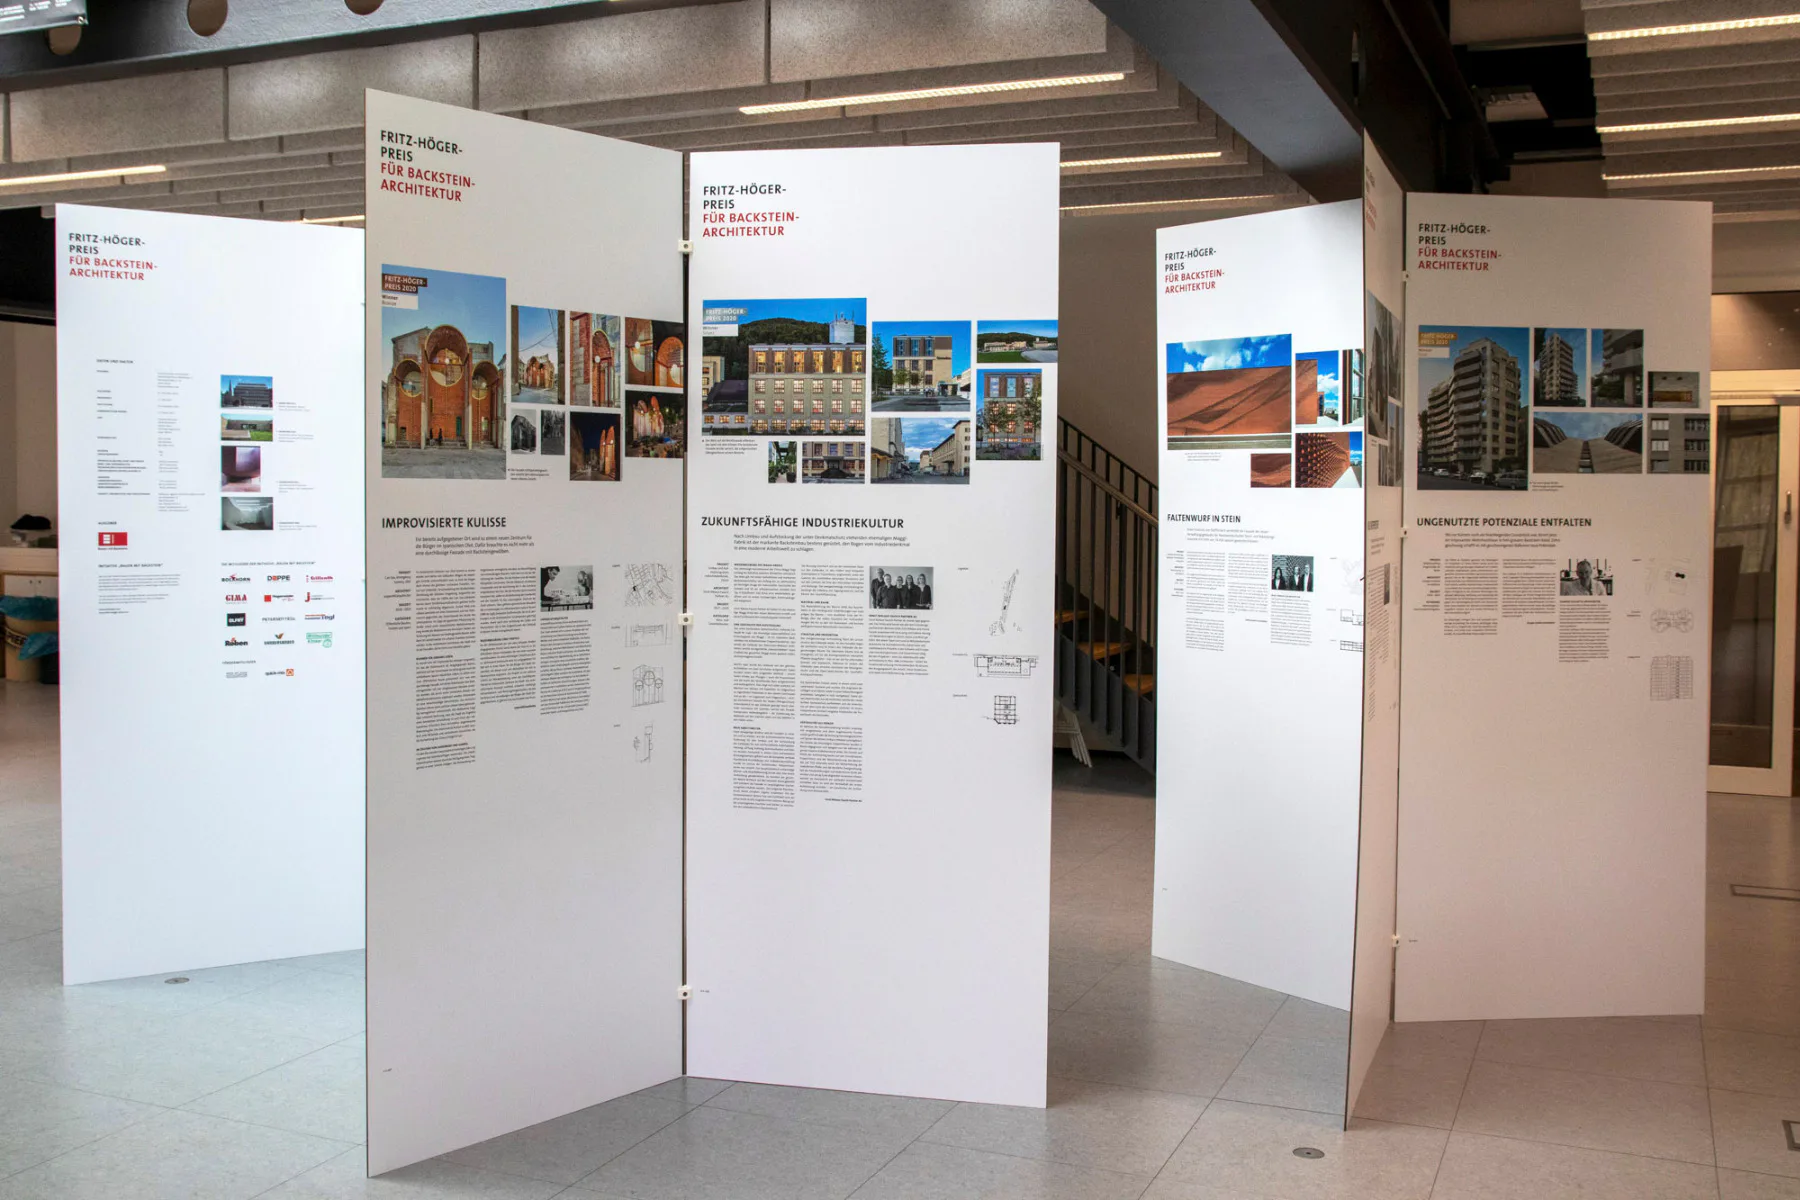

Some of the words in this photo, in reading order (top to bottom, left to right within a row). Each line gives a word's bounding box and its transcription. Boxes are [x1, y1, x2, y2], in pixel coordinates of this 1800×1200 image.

[381, 130, 463, 155] FRITZ-HÖGER-
[381, 146, 413, 162] PREIS
[381, 161, 403, 177] FÜR
[408, 167, 475, 188] BACKSTEIN-
[380, 179, 461, 202] ARCHITEKTUR
[703, 183, 786, 196] FRITZ-HÖGER-
[703, 199, 735, 210] PREIS
[703, 211, 725, 223] FÜR
[729, 211, 800, 223] BACKSTEIN-
[702, 225, 785, 238] ARCHITEKTUR
[1418, 222, 1491, 234] FRITZ-HÖGER-
[69, 232, 145, 246] FRITZ-HÖGER-
[1418, 235, 1446, 245] PREIS
[69, 244, 99, 255] PREIS
[1165, 247, 1217, 261] FRITZ-HÖGER-
[1418, 246, 1438, 257] FÜR
[1441, 248, 1502, 259] BACKSTEIN-
[69, 255, 90, 265] FÜR
[94, 257, 158, 270] BACKSTEIN-
[1165, 262, 1185, 272] PREIS
[1418, 260, 1489, 271] ARCHITEKTUR
[69, 268, 144, 281] ARCHITEKTUR
[384, 275, 426, 285] FRITZ-HÖGER-
[1165, 273, 1179, 283] FÜR
[1181, 269, 1225, 281] BACKSTEIN-
[1165, 281, 1216, 294] ARCHITEKTUR
[382, 517, 463, 528] IMPROVISIERTE
[466, 517, 506, 528] KULISSE
[701, 515, 798, 527] ZUKUNFTSFÄHIGE
[801, 517, 904, 529] INDUSTRIEKULTUR
[1167, 514, 1210, 522] FALTENWURF
[1221, 515, 1241, 523] STEIN
[1417, 518, 1480, 526] UNGENUTZTE
[1482, 518, 1538, 526] POTENZIALE
[1541, 518, 1592, 526] ENTFALTEN
